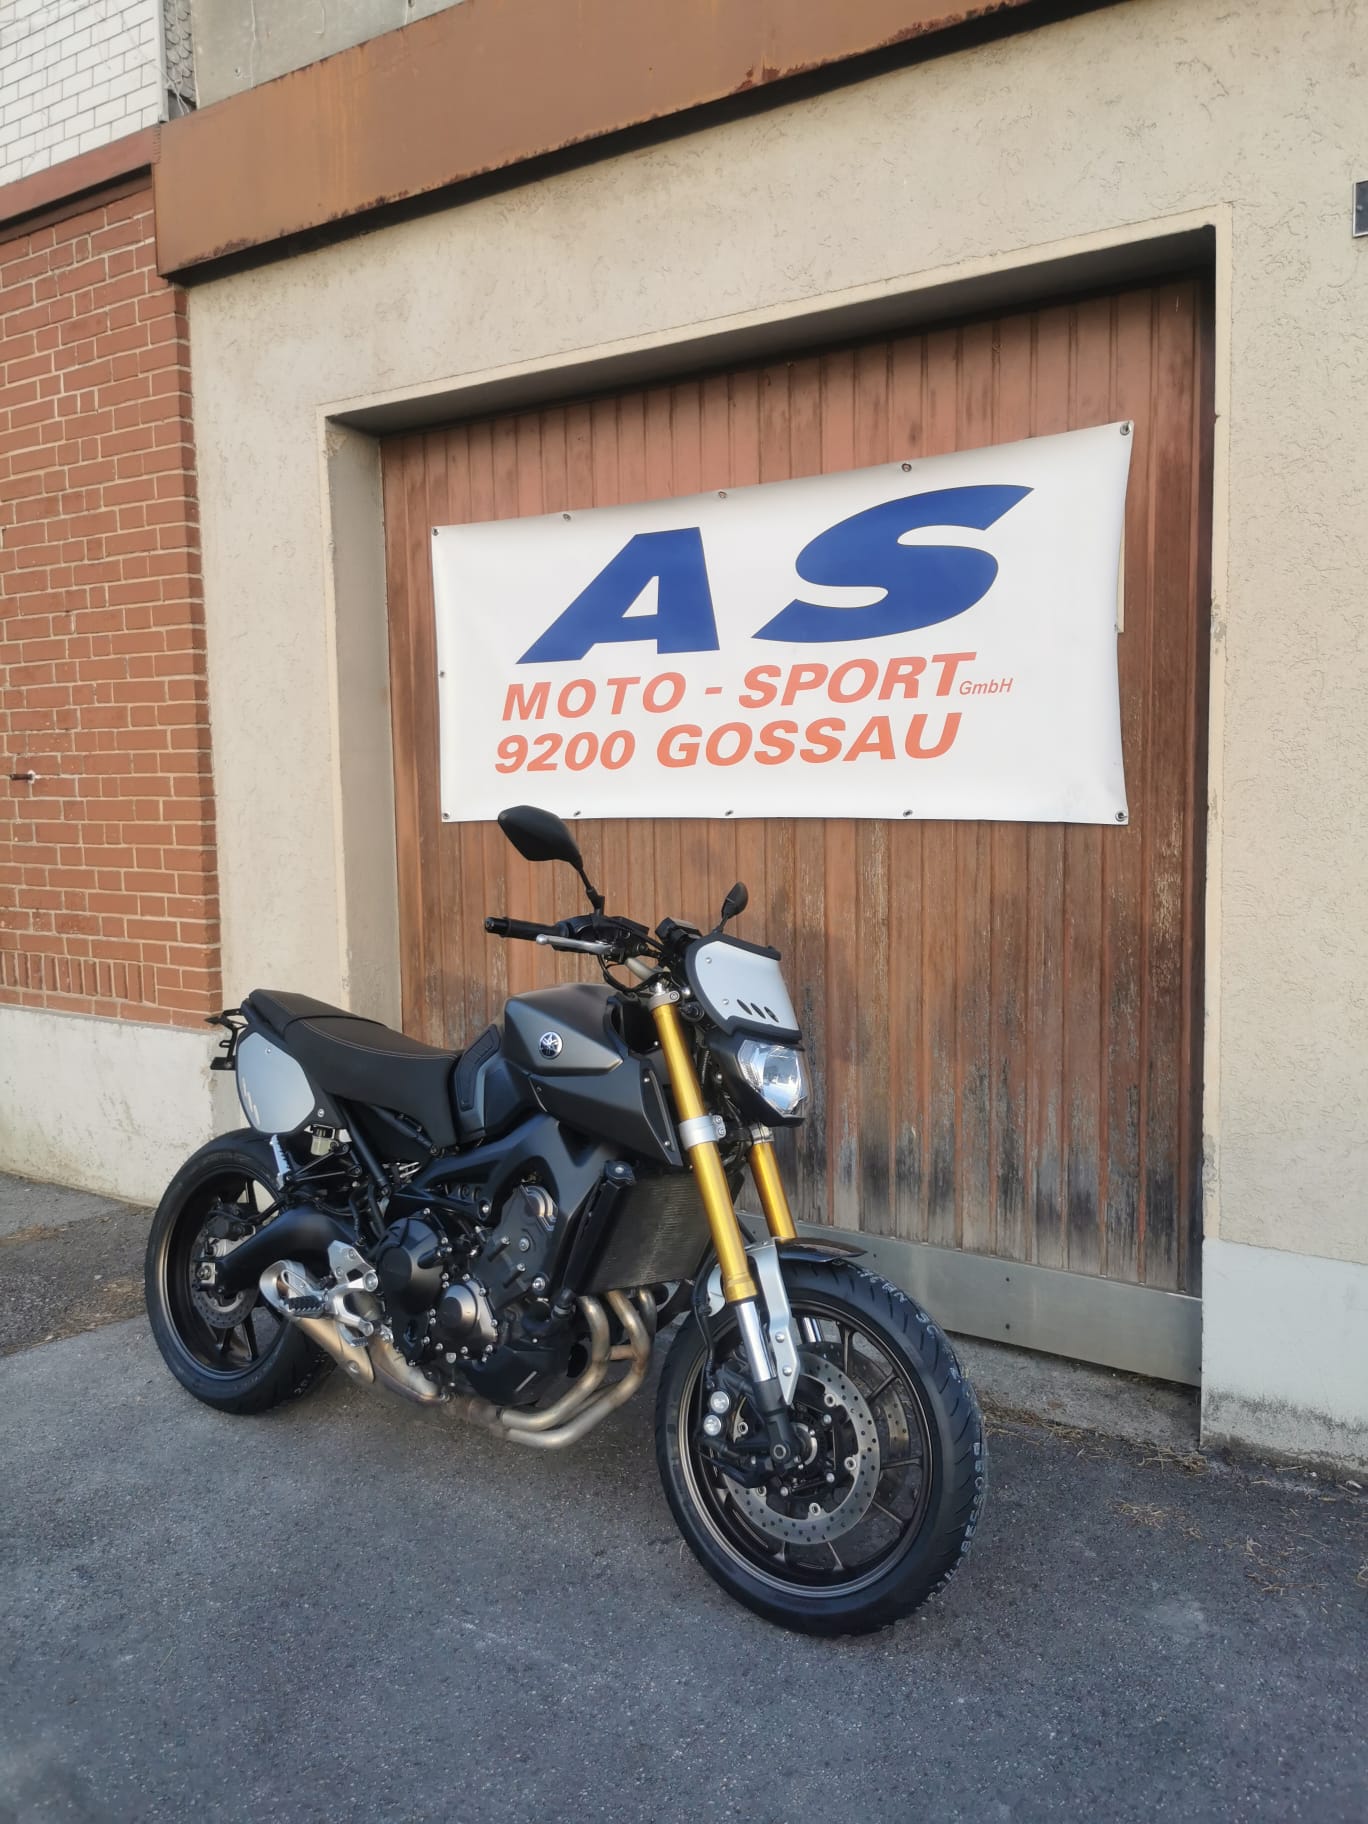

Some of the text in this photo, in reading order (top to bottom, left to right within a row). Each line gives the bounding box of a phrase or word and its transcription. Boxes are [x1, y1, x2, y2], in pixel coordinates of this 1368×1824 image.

[502, 672, 686, 721] MOTO
[738, 652, 977, 709] SPORT
[959, 678, 1013, 696] GmbH
[495, 712, 961, 775] 9200 GOSSAU
